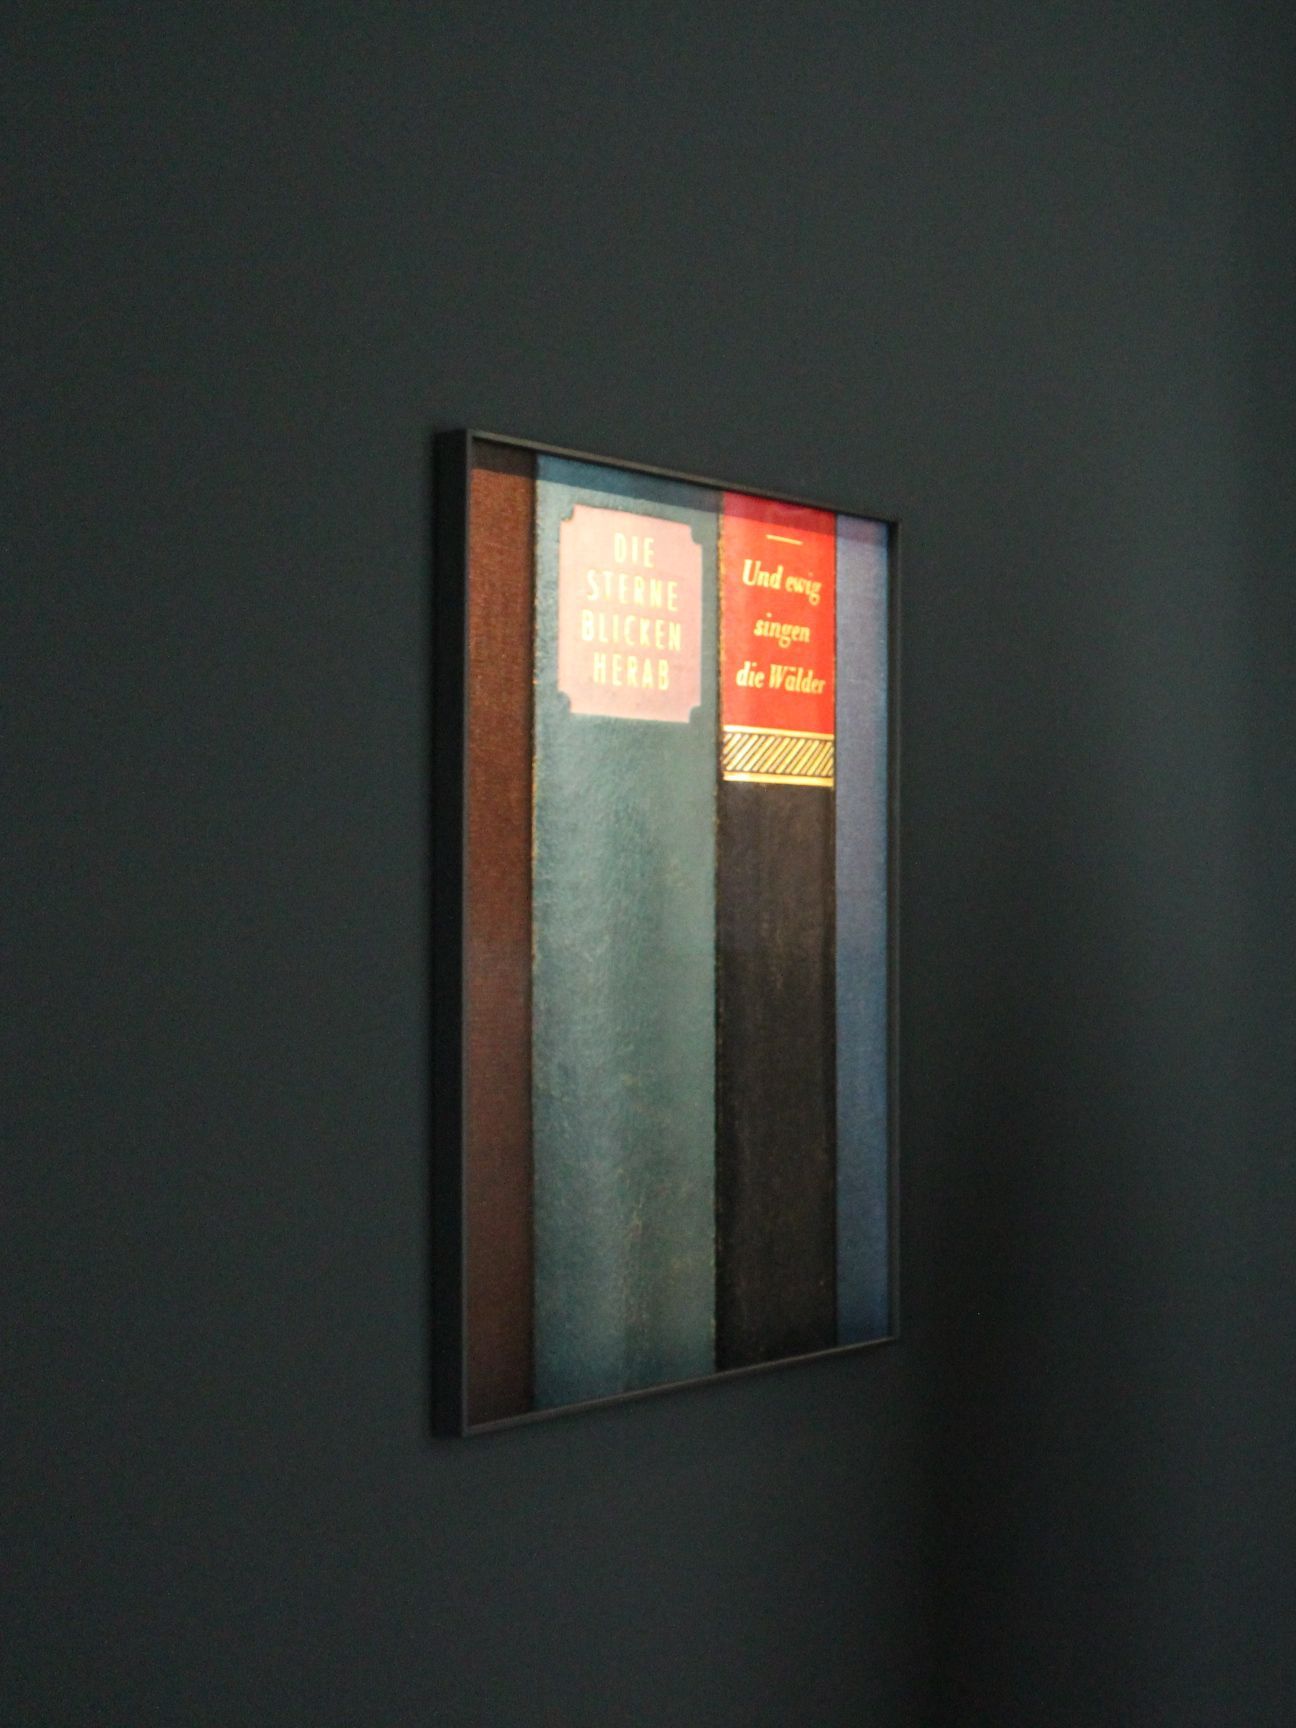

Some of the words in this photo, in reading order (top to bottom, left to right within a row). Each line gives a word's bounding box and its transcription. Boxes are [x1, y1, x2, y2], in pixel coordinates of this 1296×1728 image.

[613, 532, 655, 569] DIE
[586, 569, 679, 612] STERNE
[742, 559, 784, 591] Und
[785, 572, 822, 606] ewig
[580, 609, 682, 652] BLICKEN
[753, 612, 811, 648] singen
[593, 652, 670, 691] HERAB
[735, 660, 765, 689] die
[769, 664, 826, 695] Wälder
